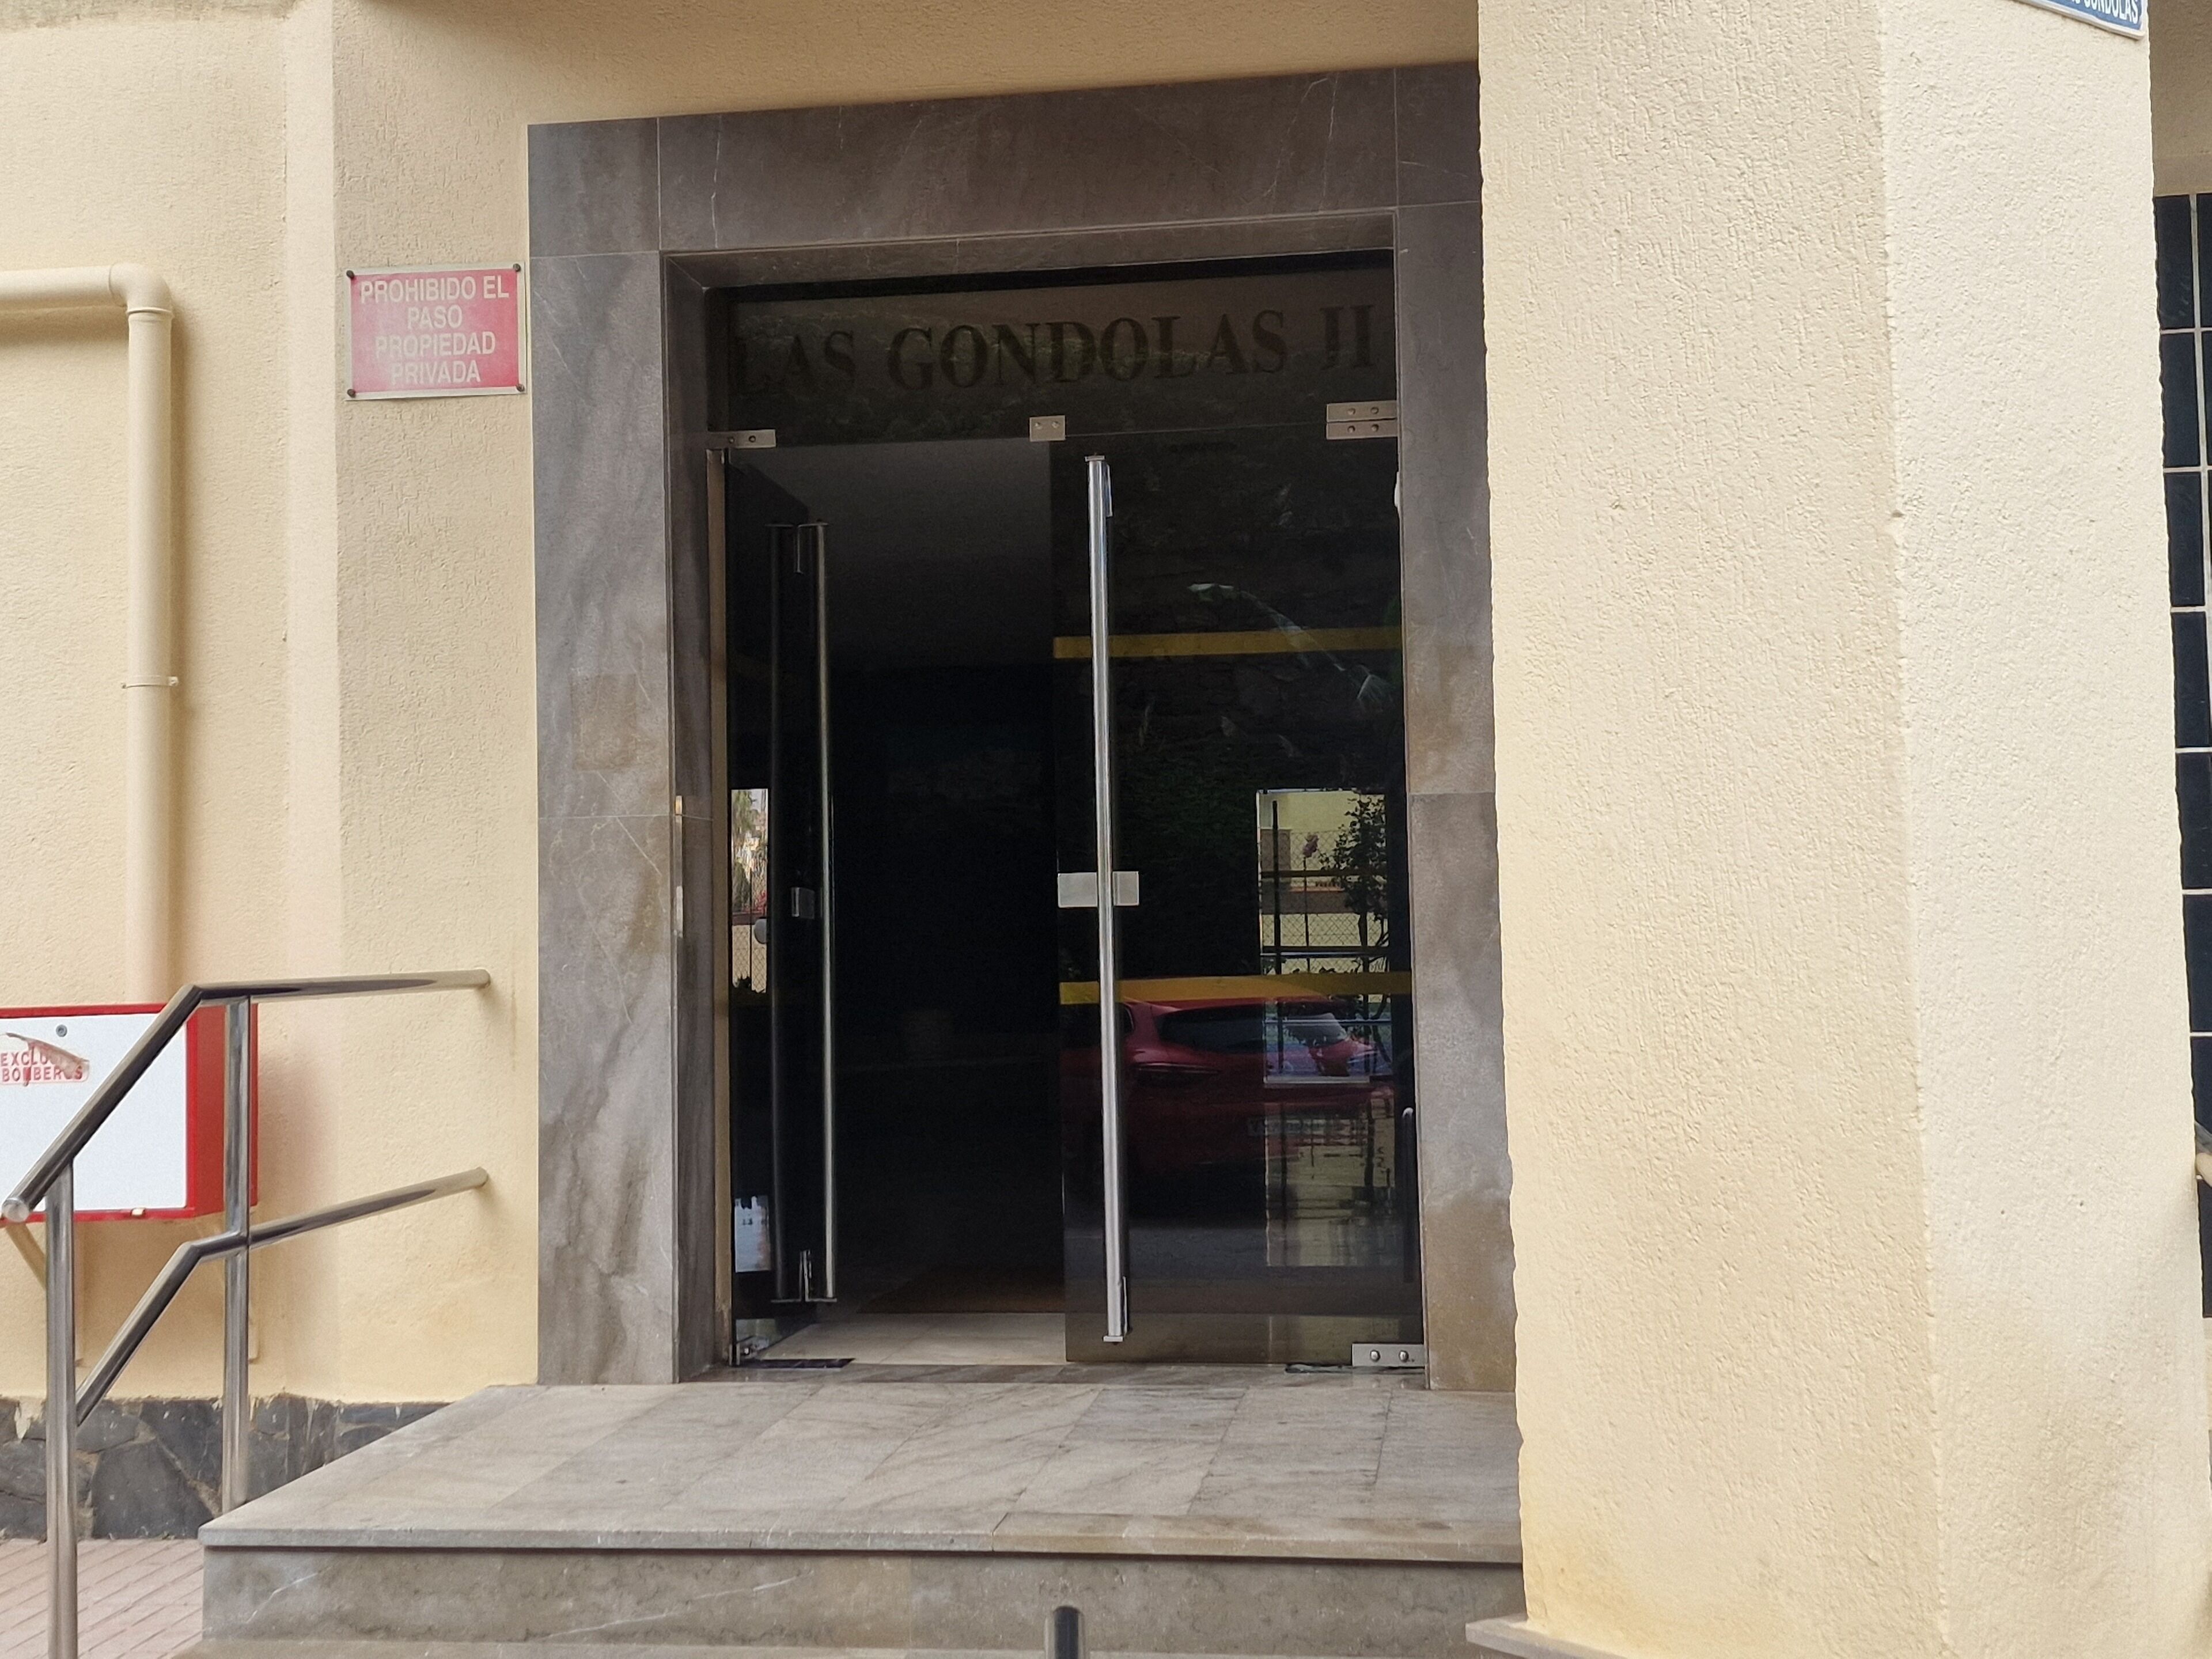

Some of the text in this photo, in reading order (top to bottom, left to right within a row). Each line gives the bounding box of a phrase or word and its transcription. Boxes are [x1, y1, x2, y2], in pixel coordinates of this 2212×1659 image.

[360, 275, 509, 304] PROHIBIDO EL
[407, 305, 463, 329] PASO
[376, 331, 496, 359] PROPIEDAD
[887, 309, 1287, 389] GONDOLAS
[1320, 304, 1375, 370] II
[391, 359, 482, 385] PRIVADA
[2, 1066, 83, 1082] BOBERS
